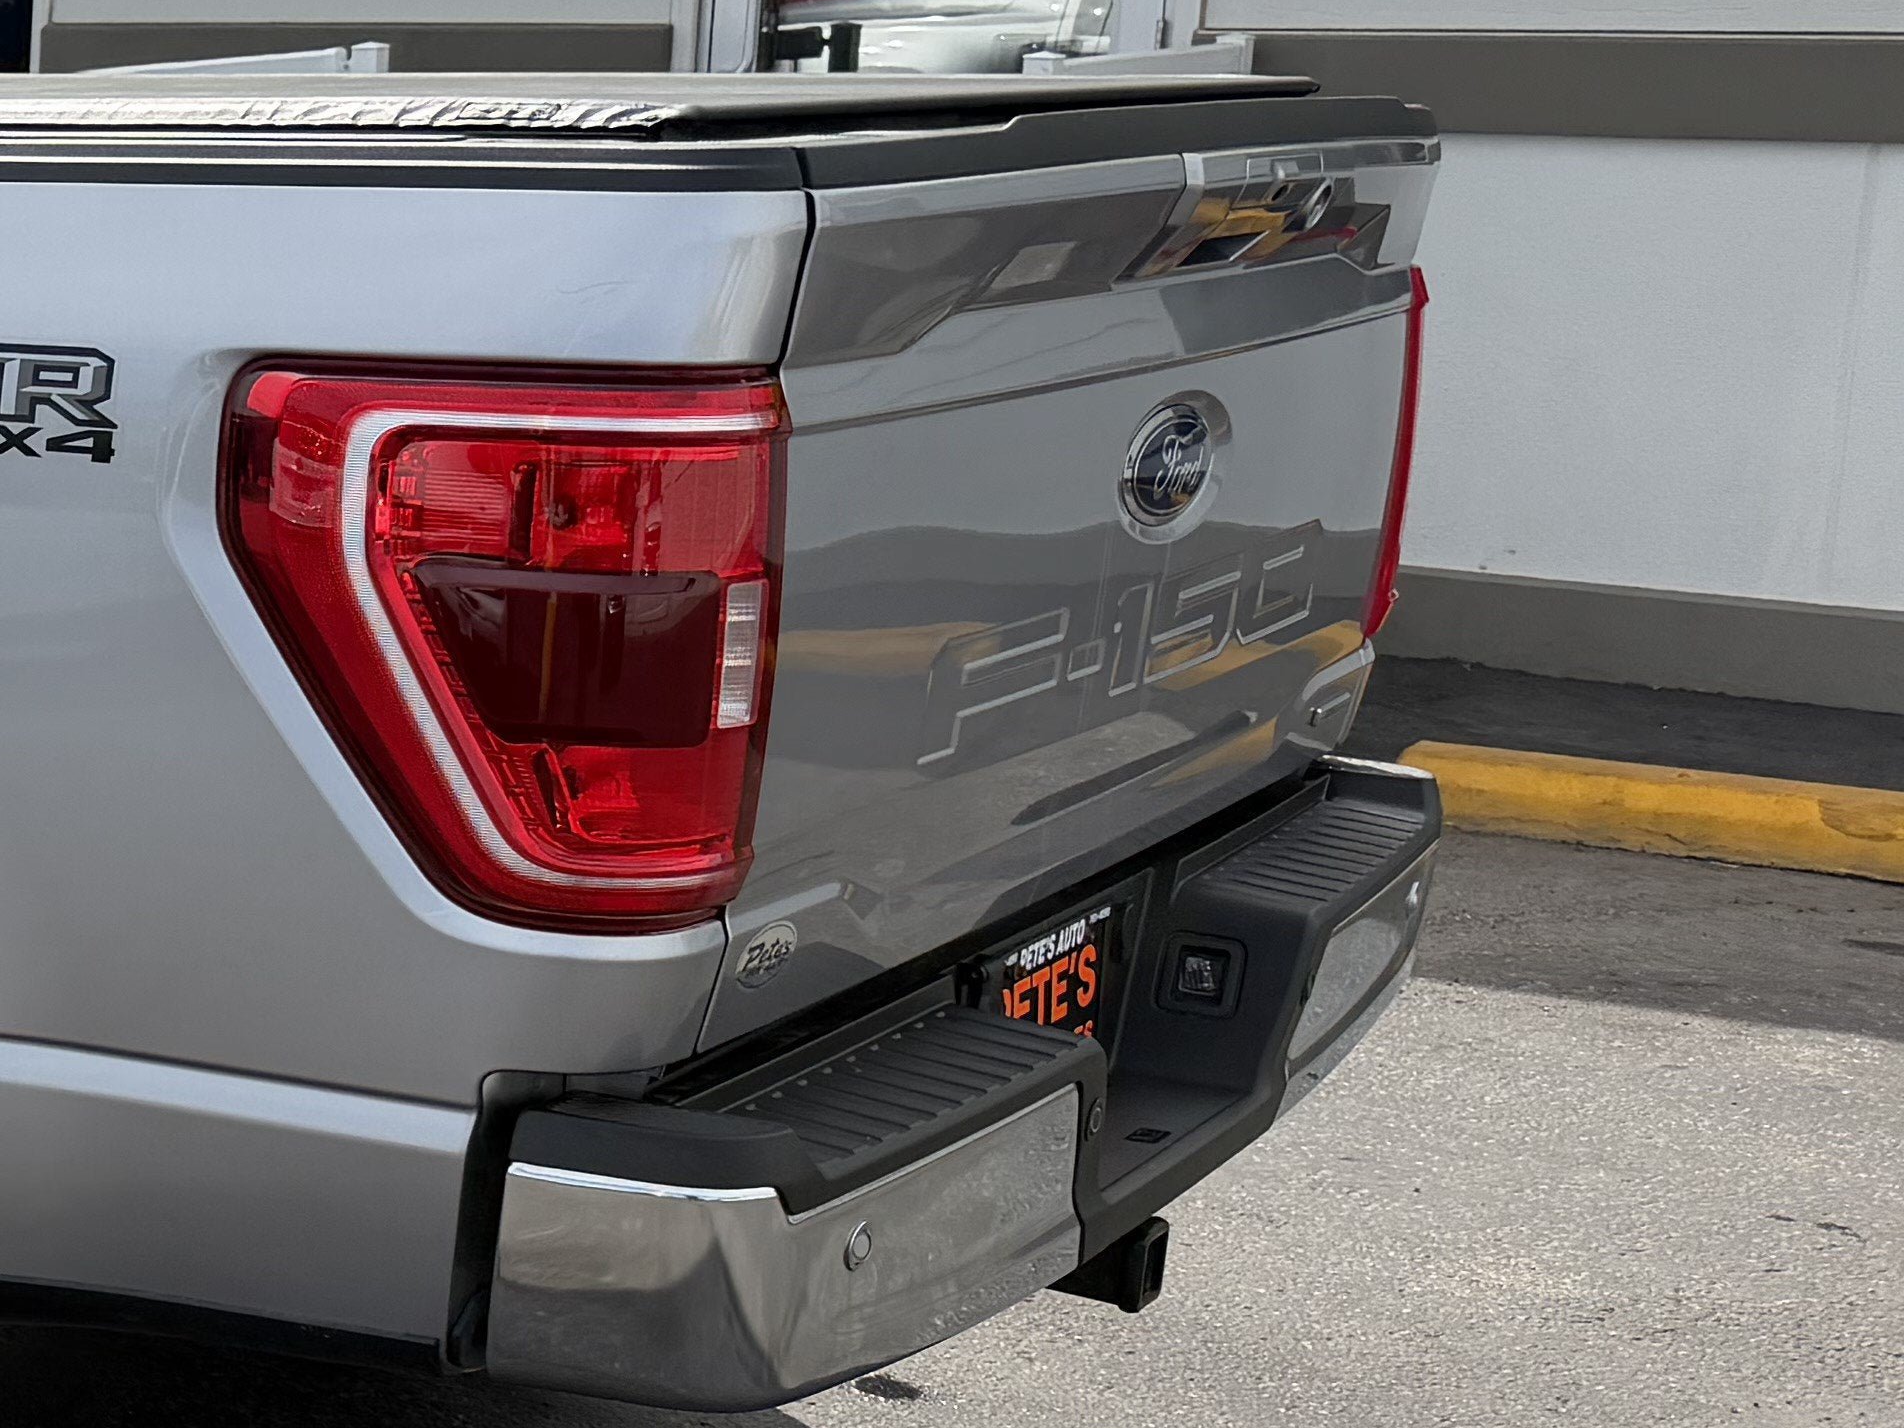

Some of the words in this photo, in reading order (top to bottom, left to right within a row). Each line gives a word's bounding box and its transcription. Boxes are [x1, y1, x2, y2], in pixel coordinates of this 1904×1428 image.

[1153, 428, 1206, 500] Ford
[917, 520, 1322, 765] F-150
[1019, 934, 1057, 971] PETE'S
[1056, 918, 1086, 956] AUTO
